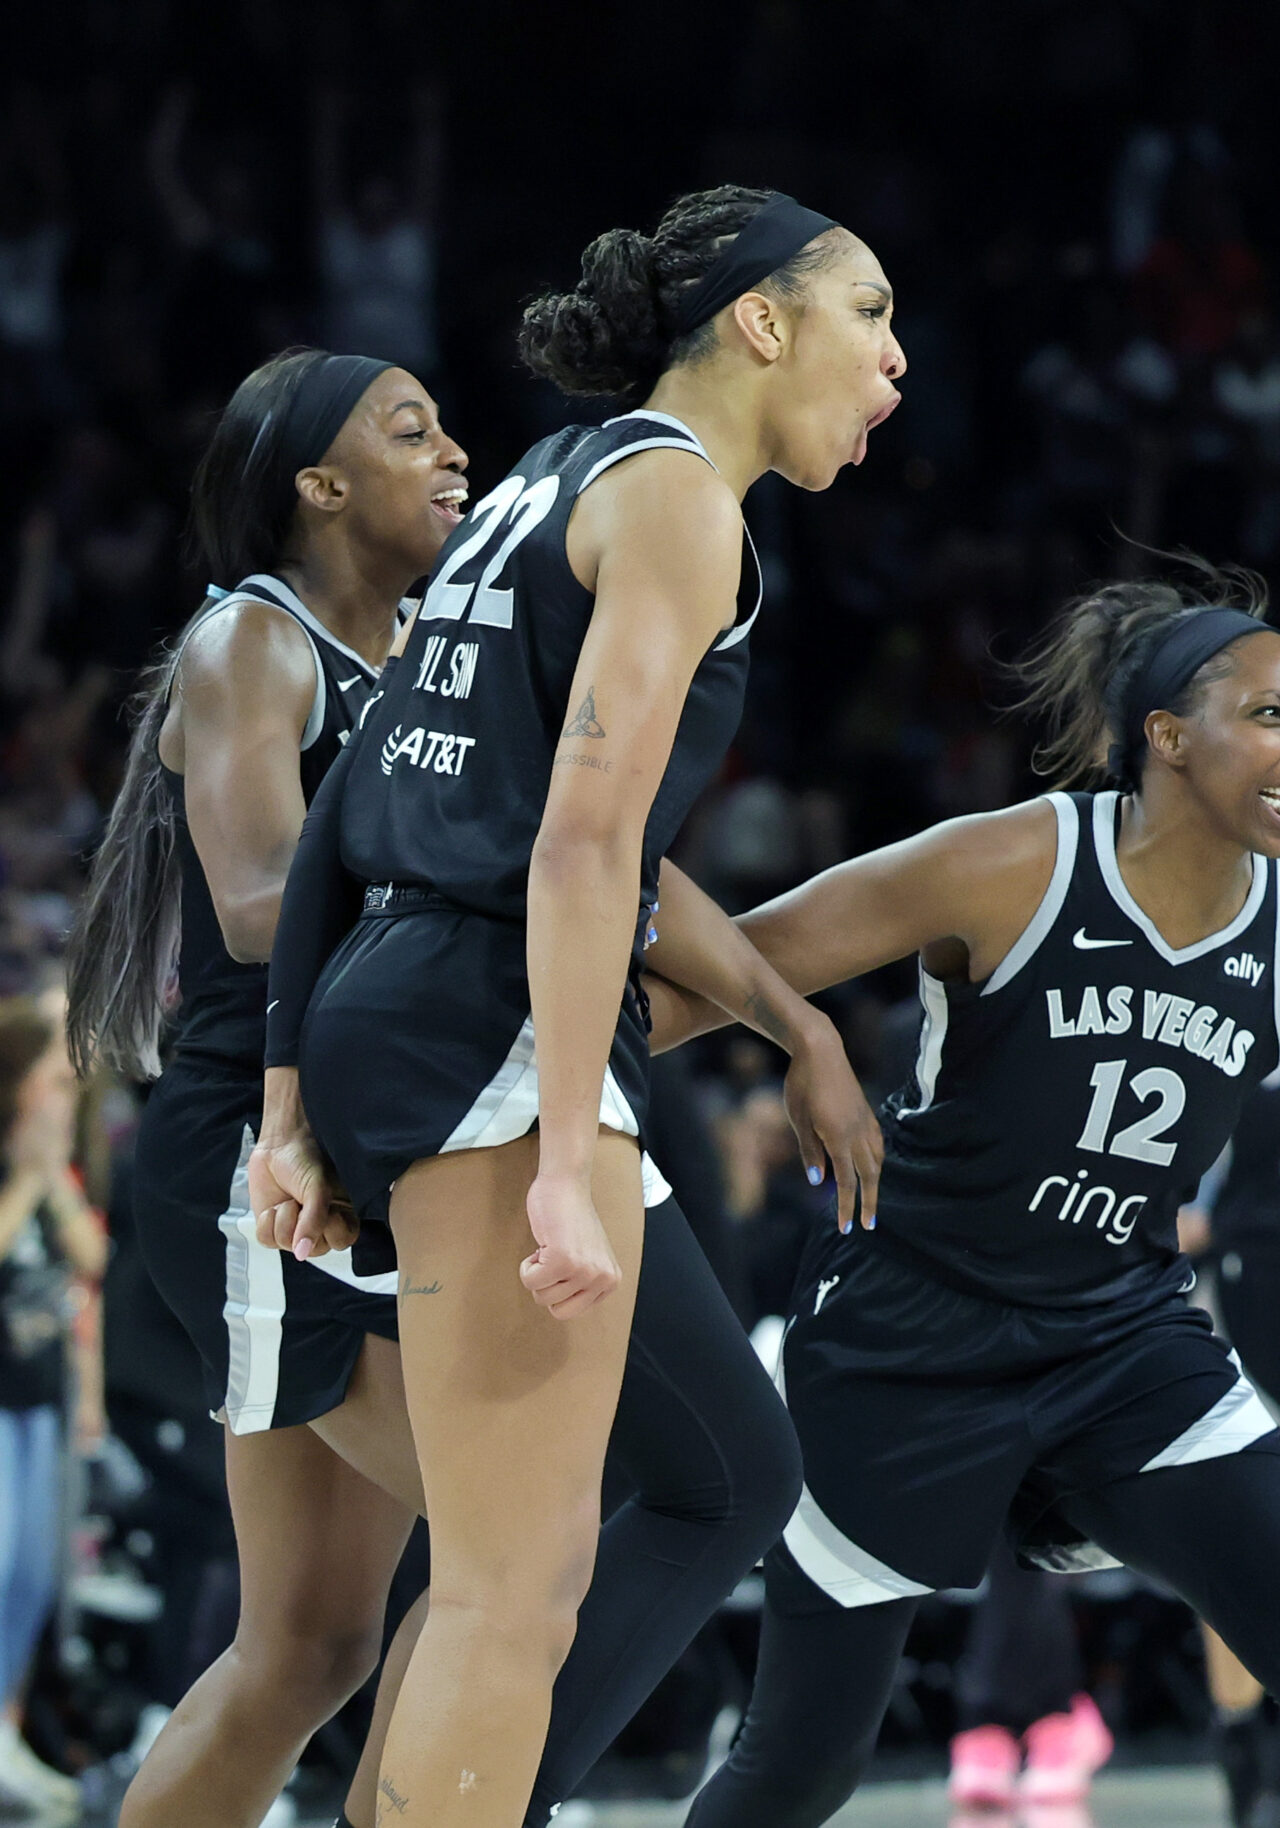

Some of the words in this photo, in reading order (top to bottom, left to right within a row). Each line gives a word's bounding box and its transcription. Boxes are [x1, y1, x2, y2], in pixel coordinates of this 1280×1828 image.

[419, 475, 560, 629] 22
[393, 727, 476, 776] AT&T
[556, 751, 614, 774] OSSIBLE
[1224, 952, 1266, 987] ally
[1046, 985, 1135, 1039] LAS
[1142, 989, 1255, 1077] VEGAS
[1075, 1059, 1187, 1167] 12
[1028, 1169, 1149, 1246] ring
